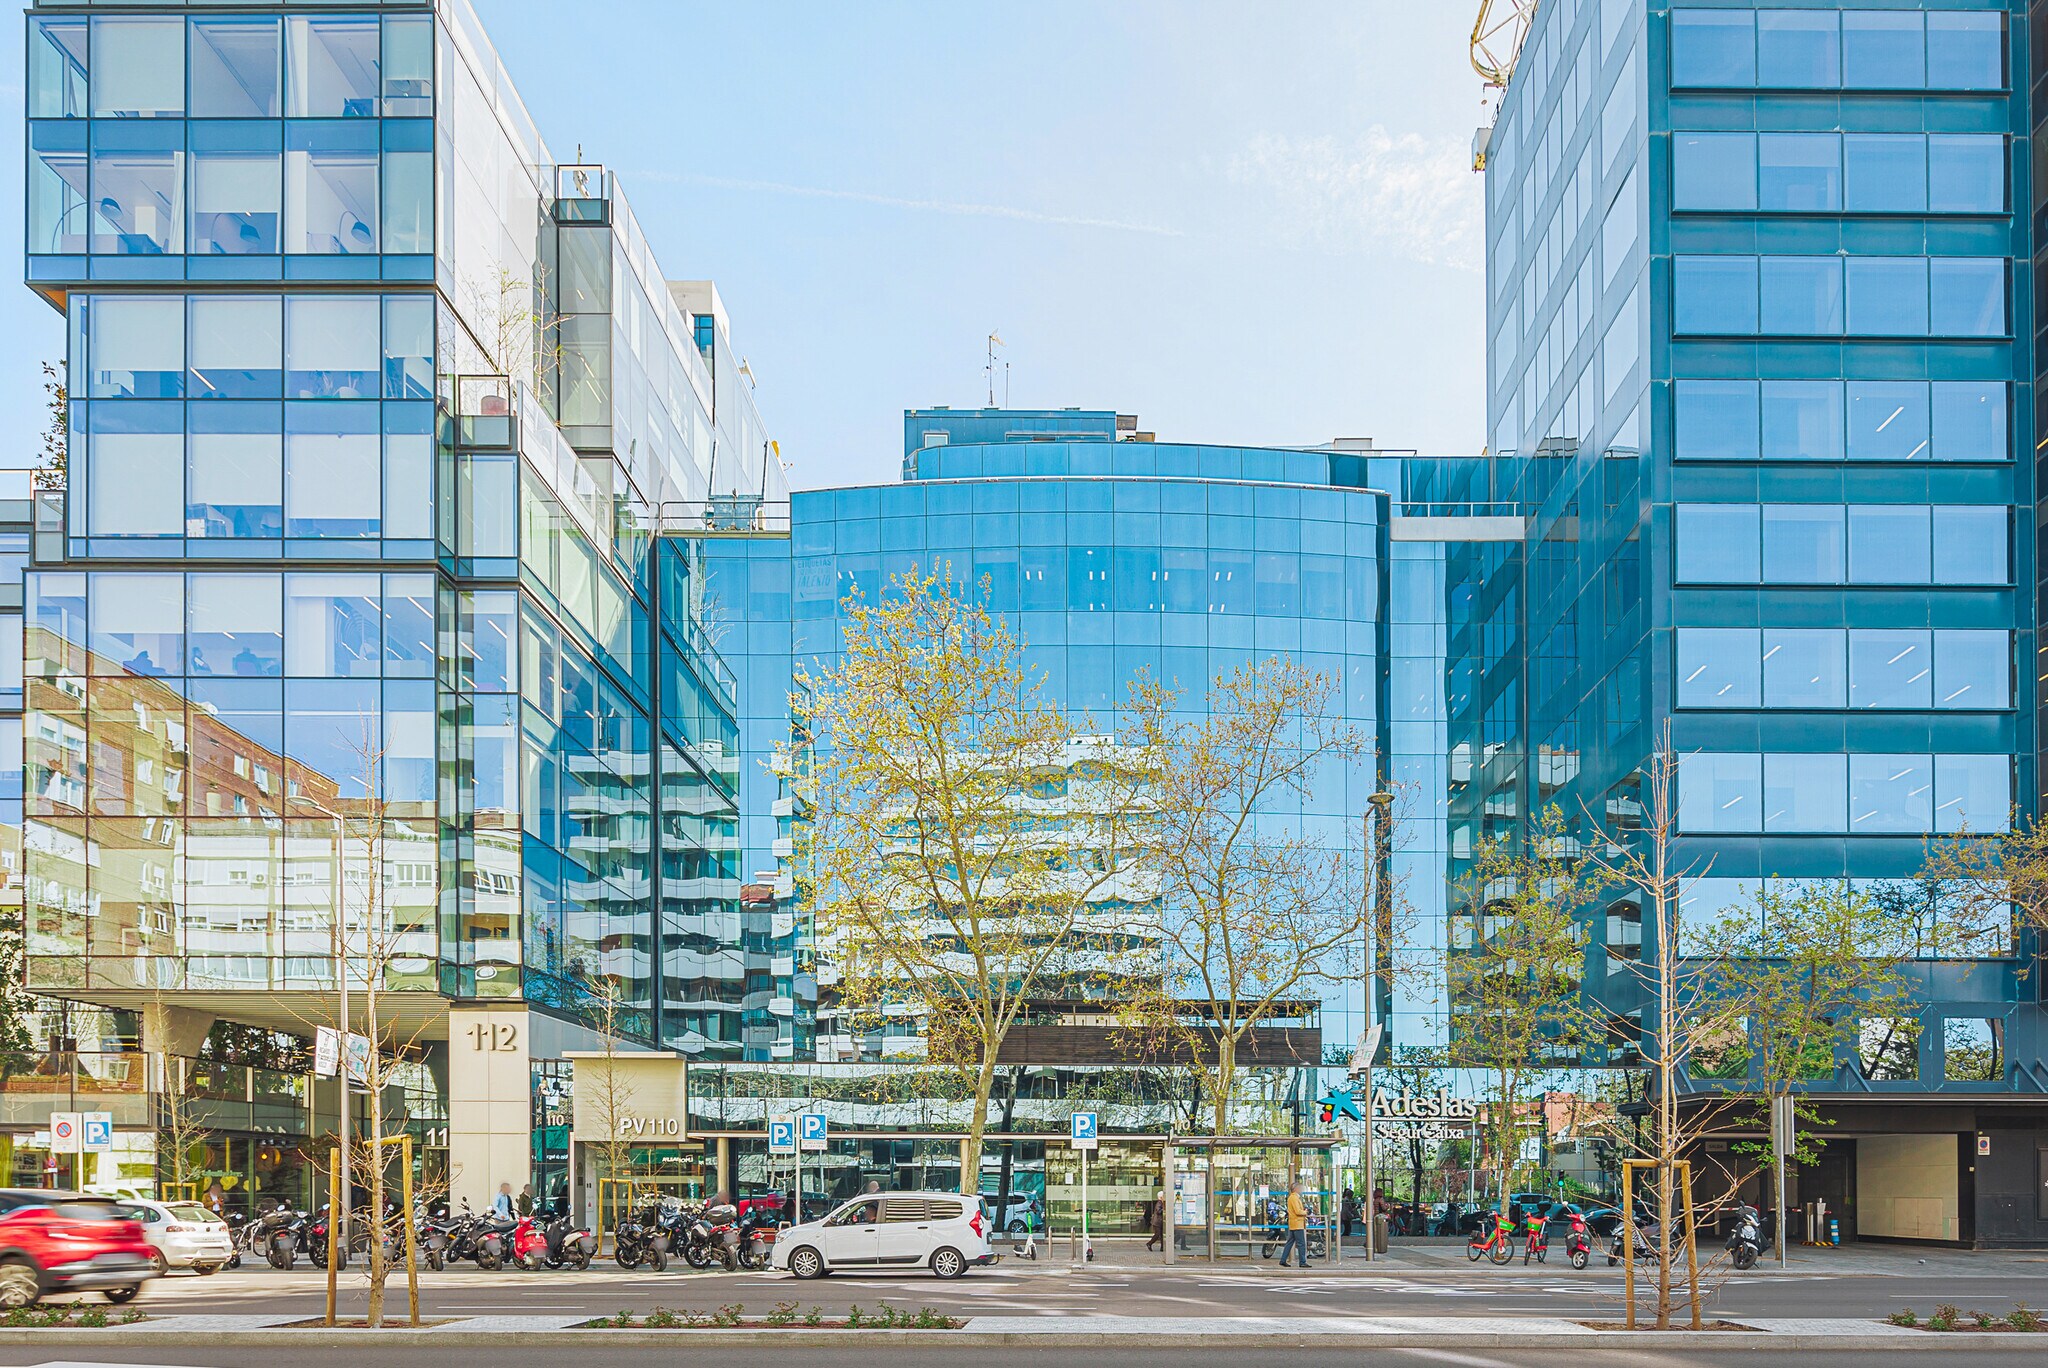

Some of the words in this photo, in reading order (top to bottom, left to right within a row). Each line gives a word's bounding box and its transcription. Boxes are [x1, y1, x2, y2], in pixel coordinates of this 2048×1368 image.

[467, 1023, 517, 1051] 112
[1371, 1086, 1477, 1117] Adeslas
[88, 1123, 104, 1143] P
[620, 1117, 646, 1135] PV
[648, 1118, 678, 1135] 110
[773, 1124, 788, 1144] P
[804, 1116, 821, 1138] P
[1075, 1115, 1090, 1137] P
[1377, 1122, 1465, 1143] SegurCaixa
[426, 1127, 448, 1147] 11
